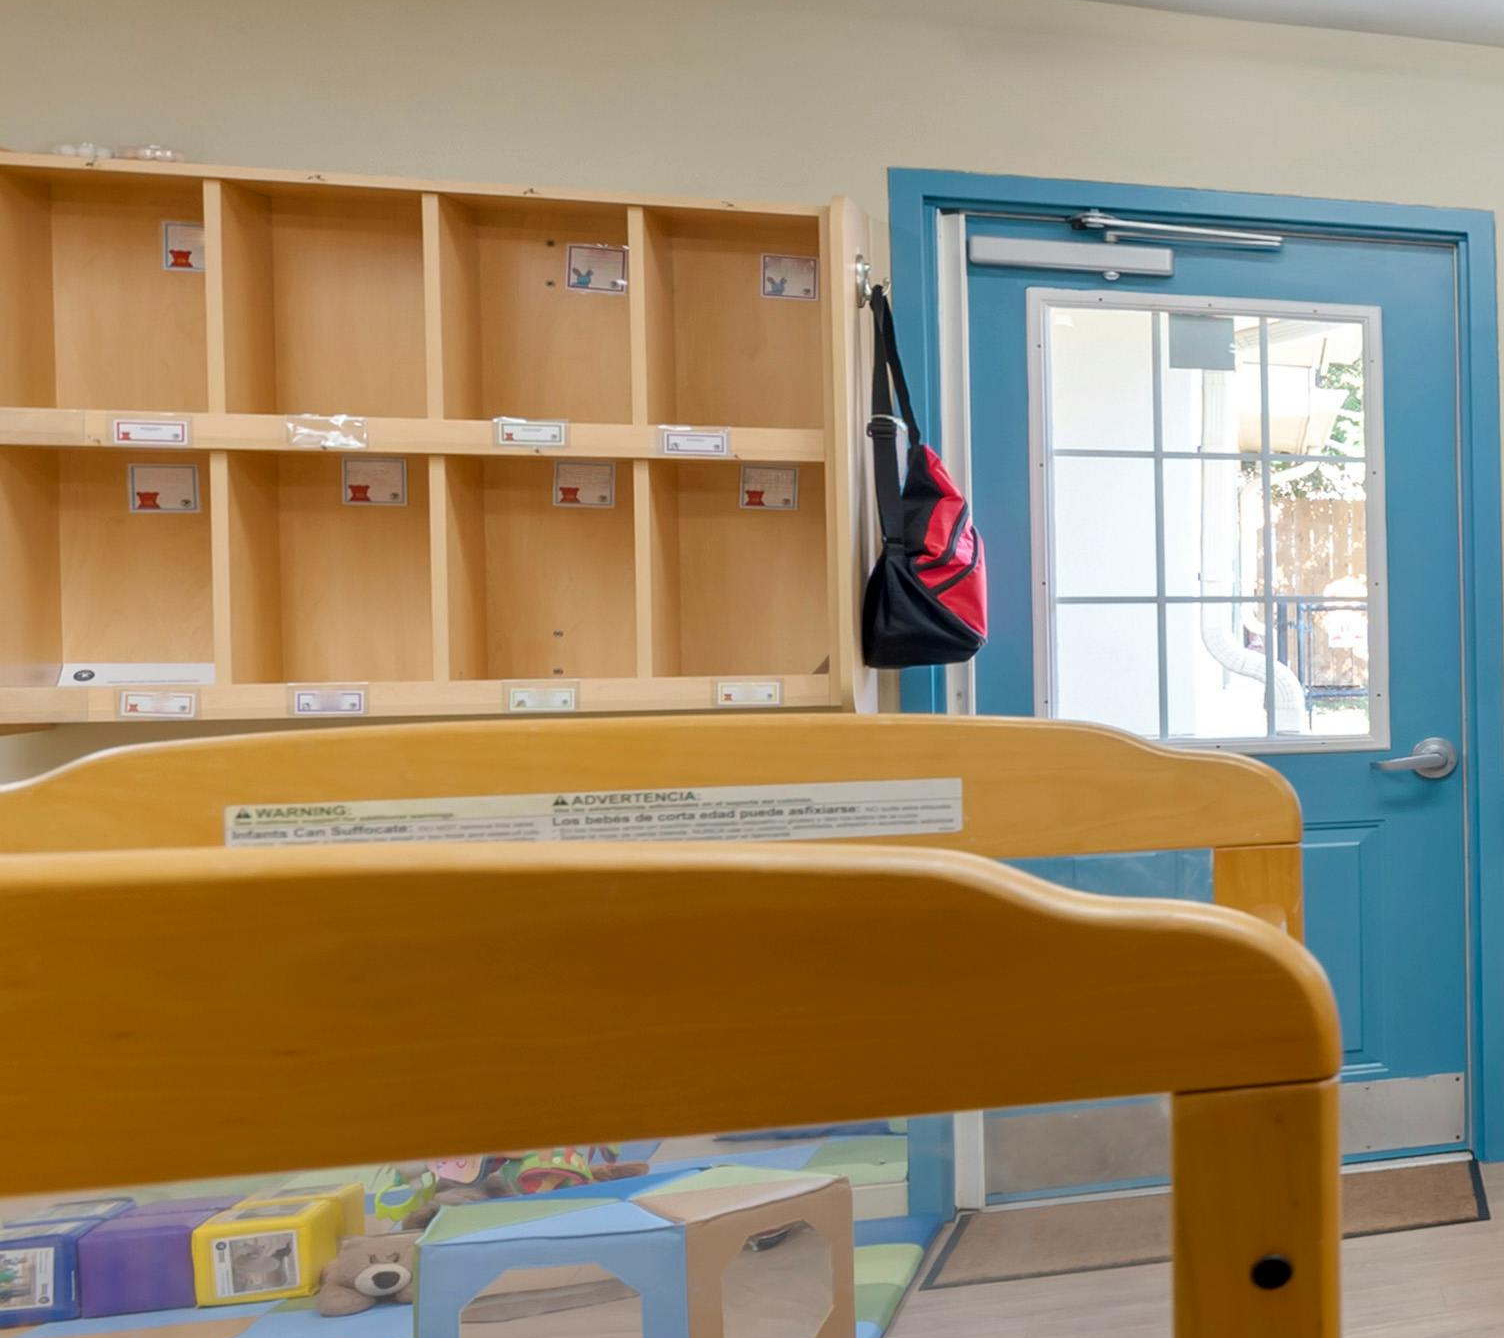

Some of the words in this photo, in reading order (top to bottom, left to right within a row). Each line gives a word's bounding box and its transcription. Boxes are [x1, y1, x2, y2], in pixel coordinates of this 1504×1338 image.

[571, 790, 702, 806] ADVERTENCIA:
[254, 805, 353, 819] WARNING:
[552, 816, 580, 828] Los
[634, 813, 653, 823] de
[657, 811, 696, 822] corta
[699, 809, 736, 820] edad
[738, 807, 784, 820] puede
[787, 804, 861, 816] asfixiarse:
[231, 827, 289, 841] Infants
[293, 826, 327, 838] Can
[331, 824, 413, 837] Suffocate:
